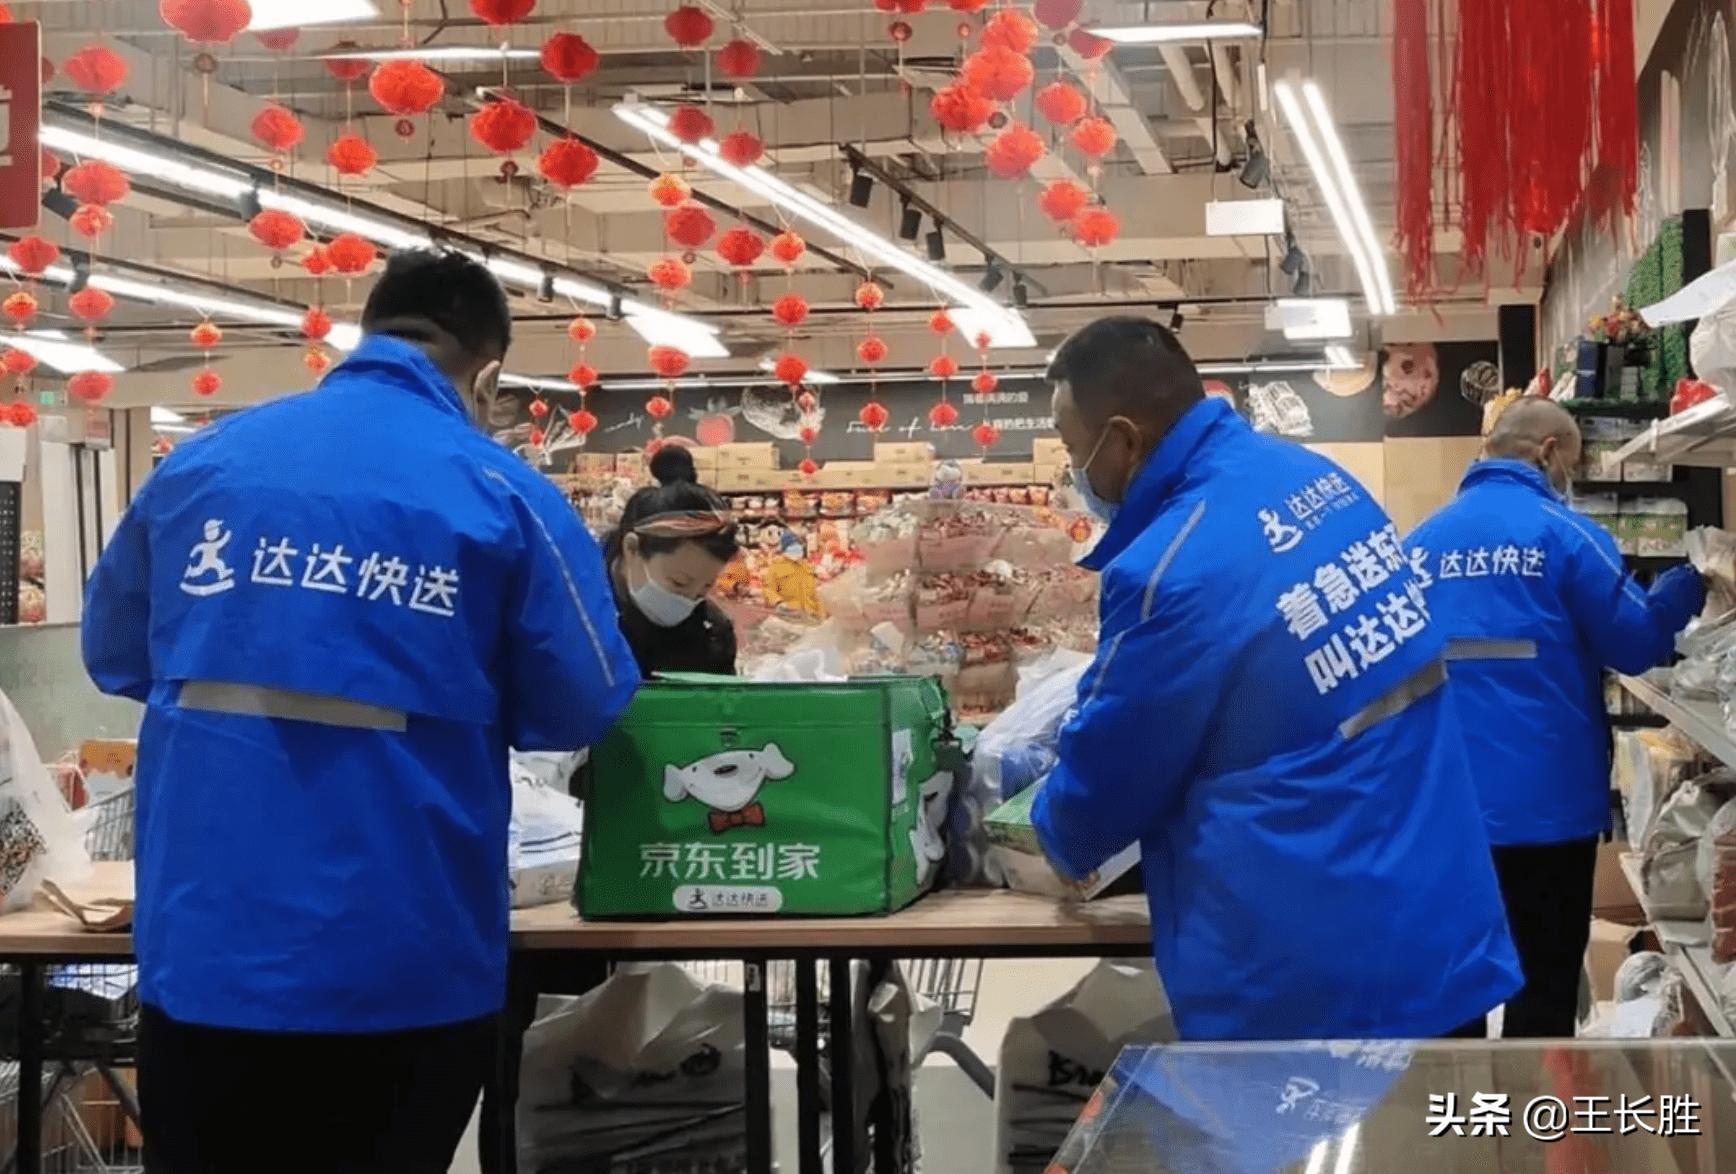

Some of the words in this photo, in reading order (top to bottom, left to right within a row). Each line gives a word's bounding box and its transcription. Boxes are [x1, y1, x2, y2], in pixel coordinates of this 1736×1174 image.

[1284, 472, 1352, 521] 达达快送
[250, 536, 460, 617] 达达快送
[1439, 544, 1546, 579] 达达快送
[638, 841, 821, 881] 京东到家
